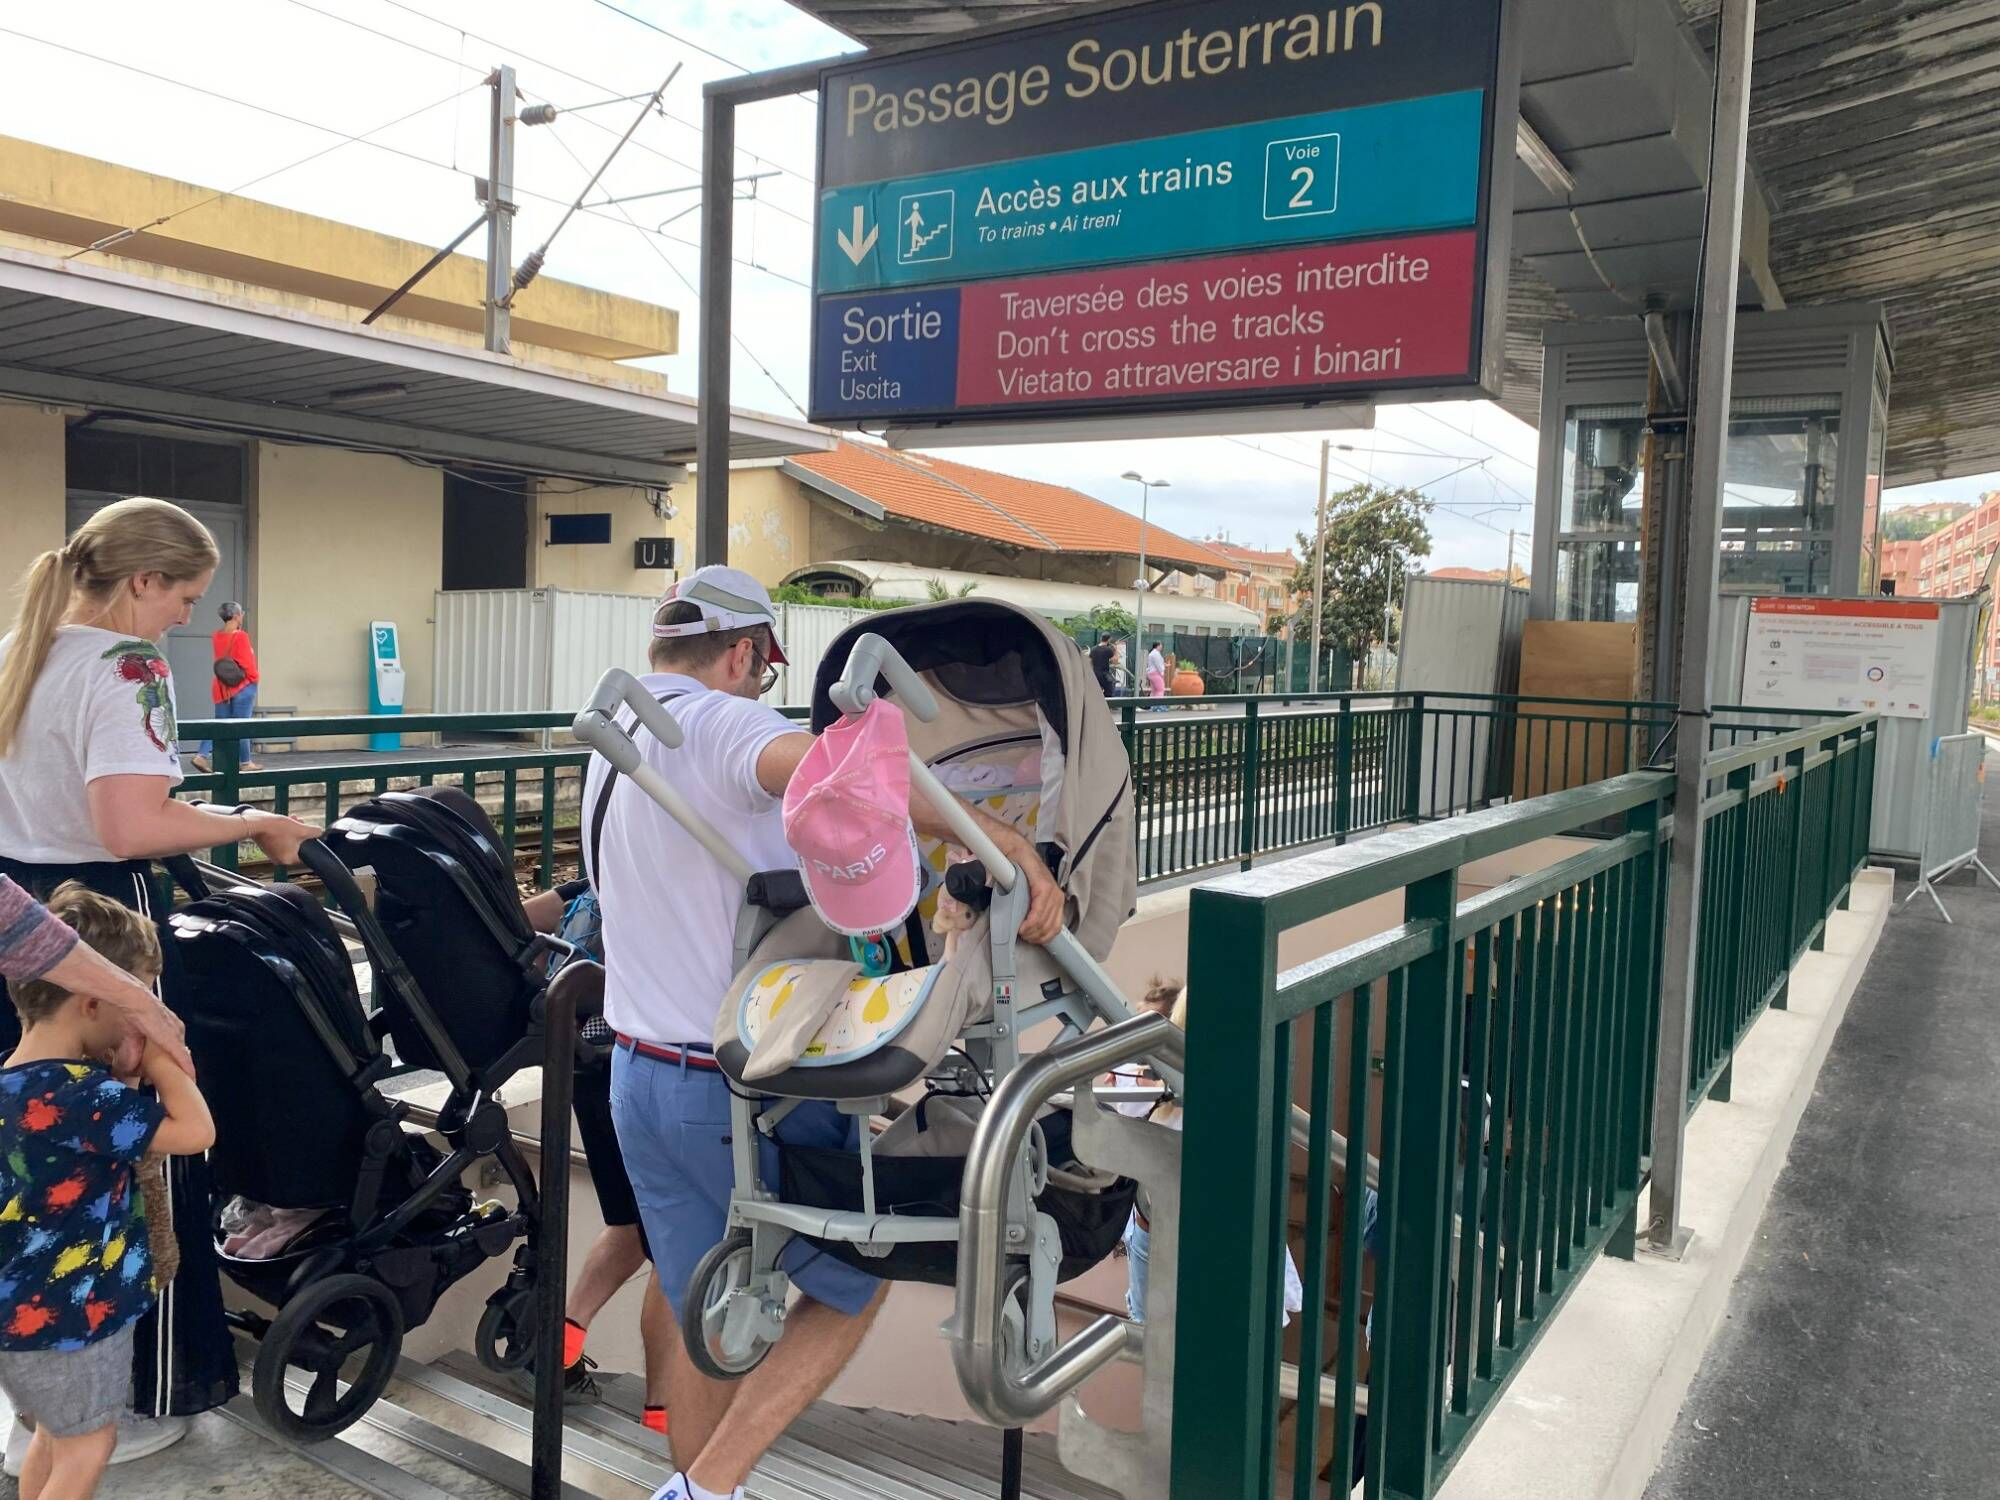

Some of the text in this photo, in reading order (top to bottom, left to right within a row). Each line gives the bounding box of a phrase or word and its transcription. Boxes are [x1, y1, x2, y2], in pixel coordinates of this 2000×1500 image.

[845, 1, 1383, 138] Passage Souterrain
[1284, 144, 1320, 161] Voie
[974, 159, 1234, 217] Accès aux trains
[1288, 167, 1315, 209] 2
[978, 209, 1122, 242] To trains Ai treni
[1000, 252, 1430, 320] Traversée des voies interdite
[842, 301, 942, 345] Sortie
[997, 305, 1325, 359] Don't cross the tracks
[840, 349, 878, 374] Exit
[997, 338, 1402, 396] Vietato attraversare i binari
[840, 378, 902, 401] Uscita
[642, 543, 656, 566] U
[812, 843, 886, 879] PARIS
